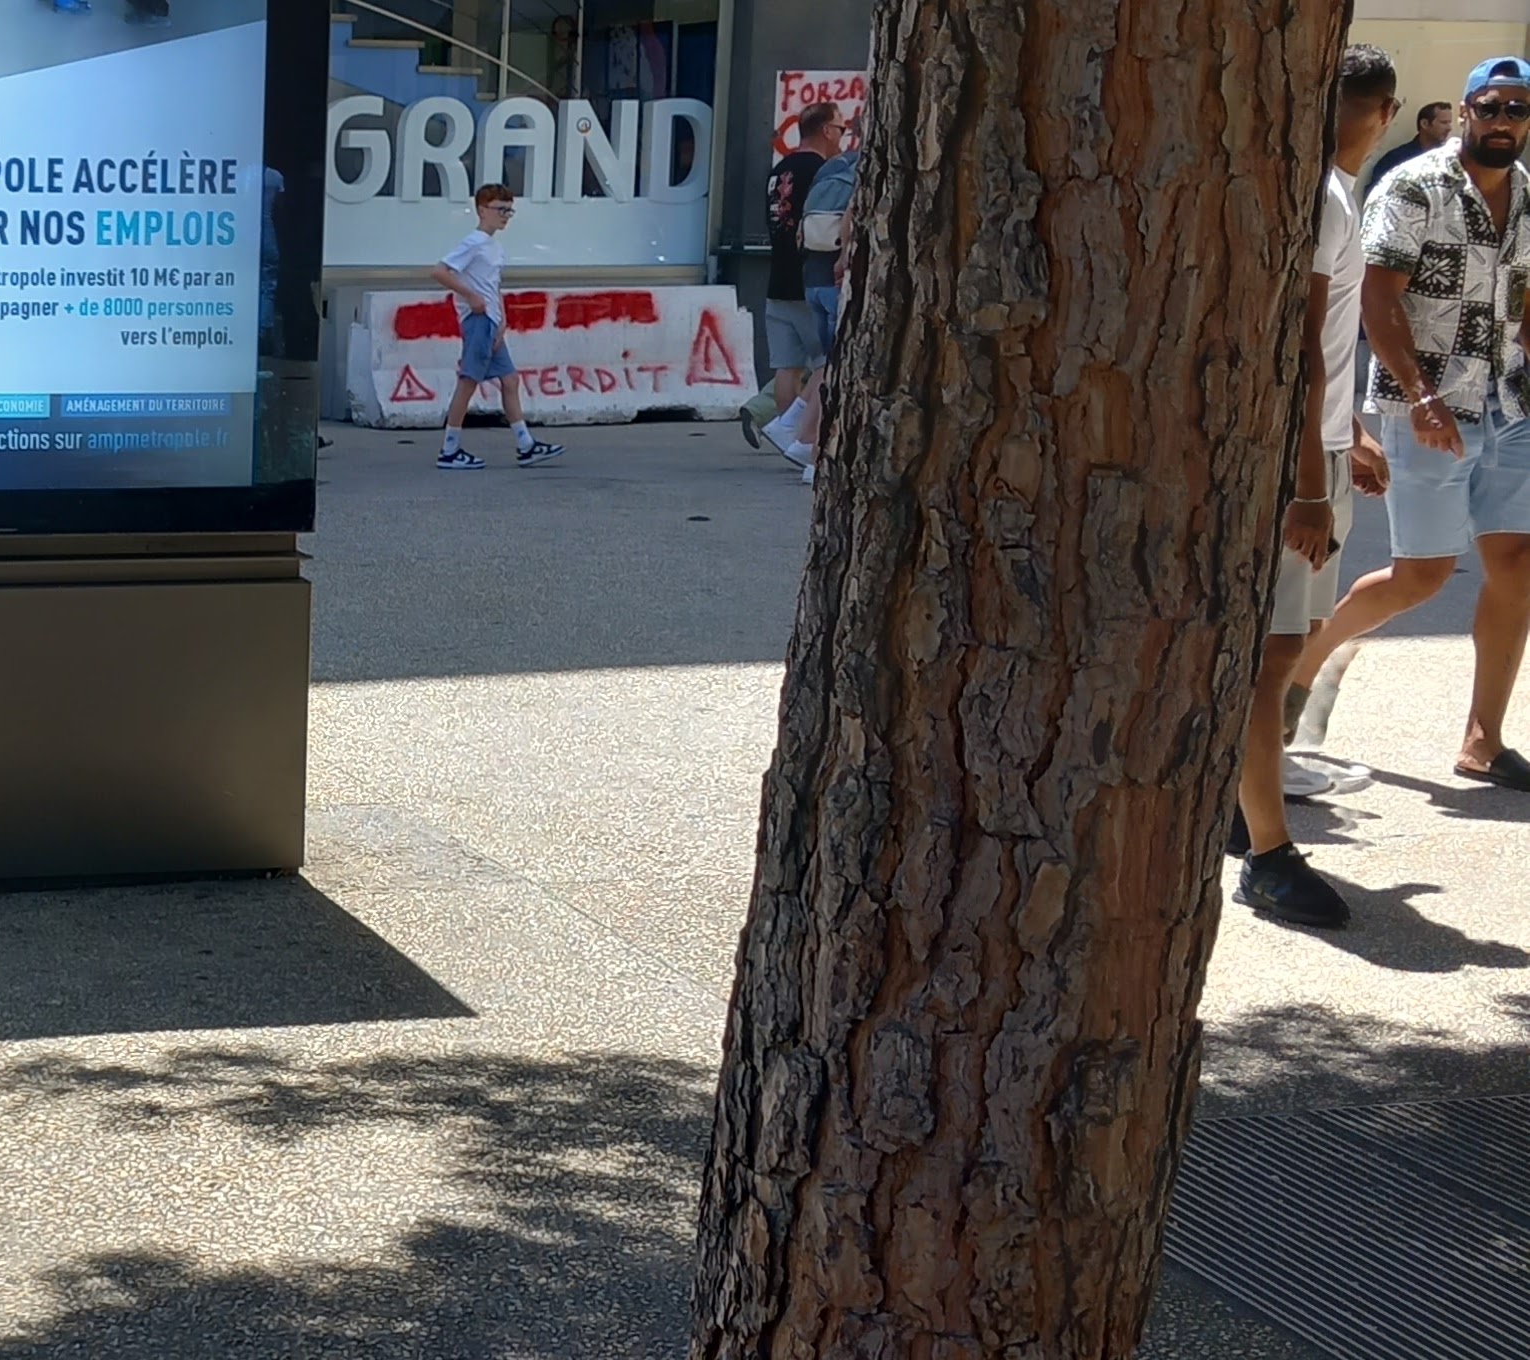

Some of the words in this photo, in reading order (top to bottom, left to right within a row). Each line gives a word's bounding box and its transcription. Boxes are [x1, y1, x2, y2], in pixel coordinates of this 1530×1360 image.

[325, 95, 713, 203] GRAND
[72, 150, 238, 195] ACCÉLÈRE
[20, 209, 86, 247] NOS
[96, 210, 236, 246] EMPLOIS
[60, 267, 126, 287] investit
[130, 267, 150, 287] 10
[154, 267, 181, 287] M€
[183, 270, 212, 290] par
[214, 271, 235, 286] an
[79, 297, 100, 316] de
[103, 297, 143, 316] 8000
[147, 301, 234, 320] personnes
[120, 330, 158, 346] vers
[161, 326, 234, 349] l'emploi.
[66, 396, 145, 413] AMÉNAGEMENT
[148, 399, 163, 412] DU
[165, 398, 226, 412] TERRITOIRE
[54, 432, 83, 450] sur
[87, 428, 229, 455] ampmetropole.fr
